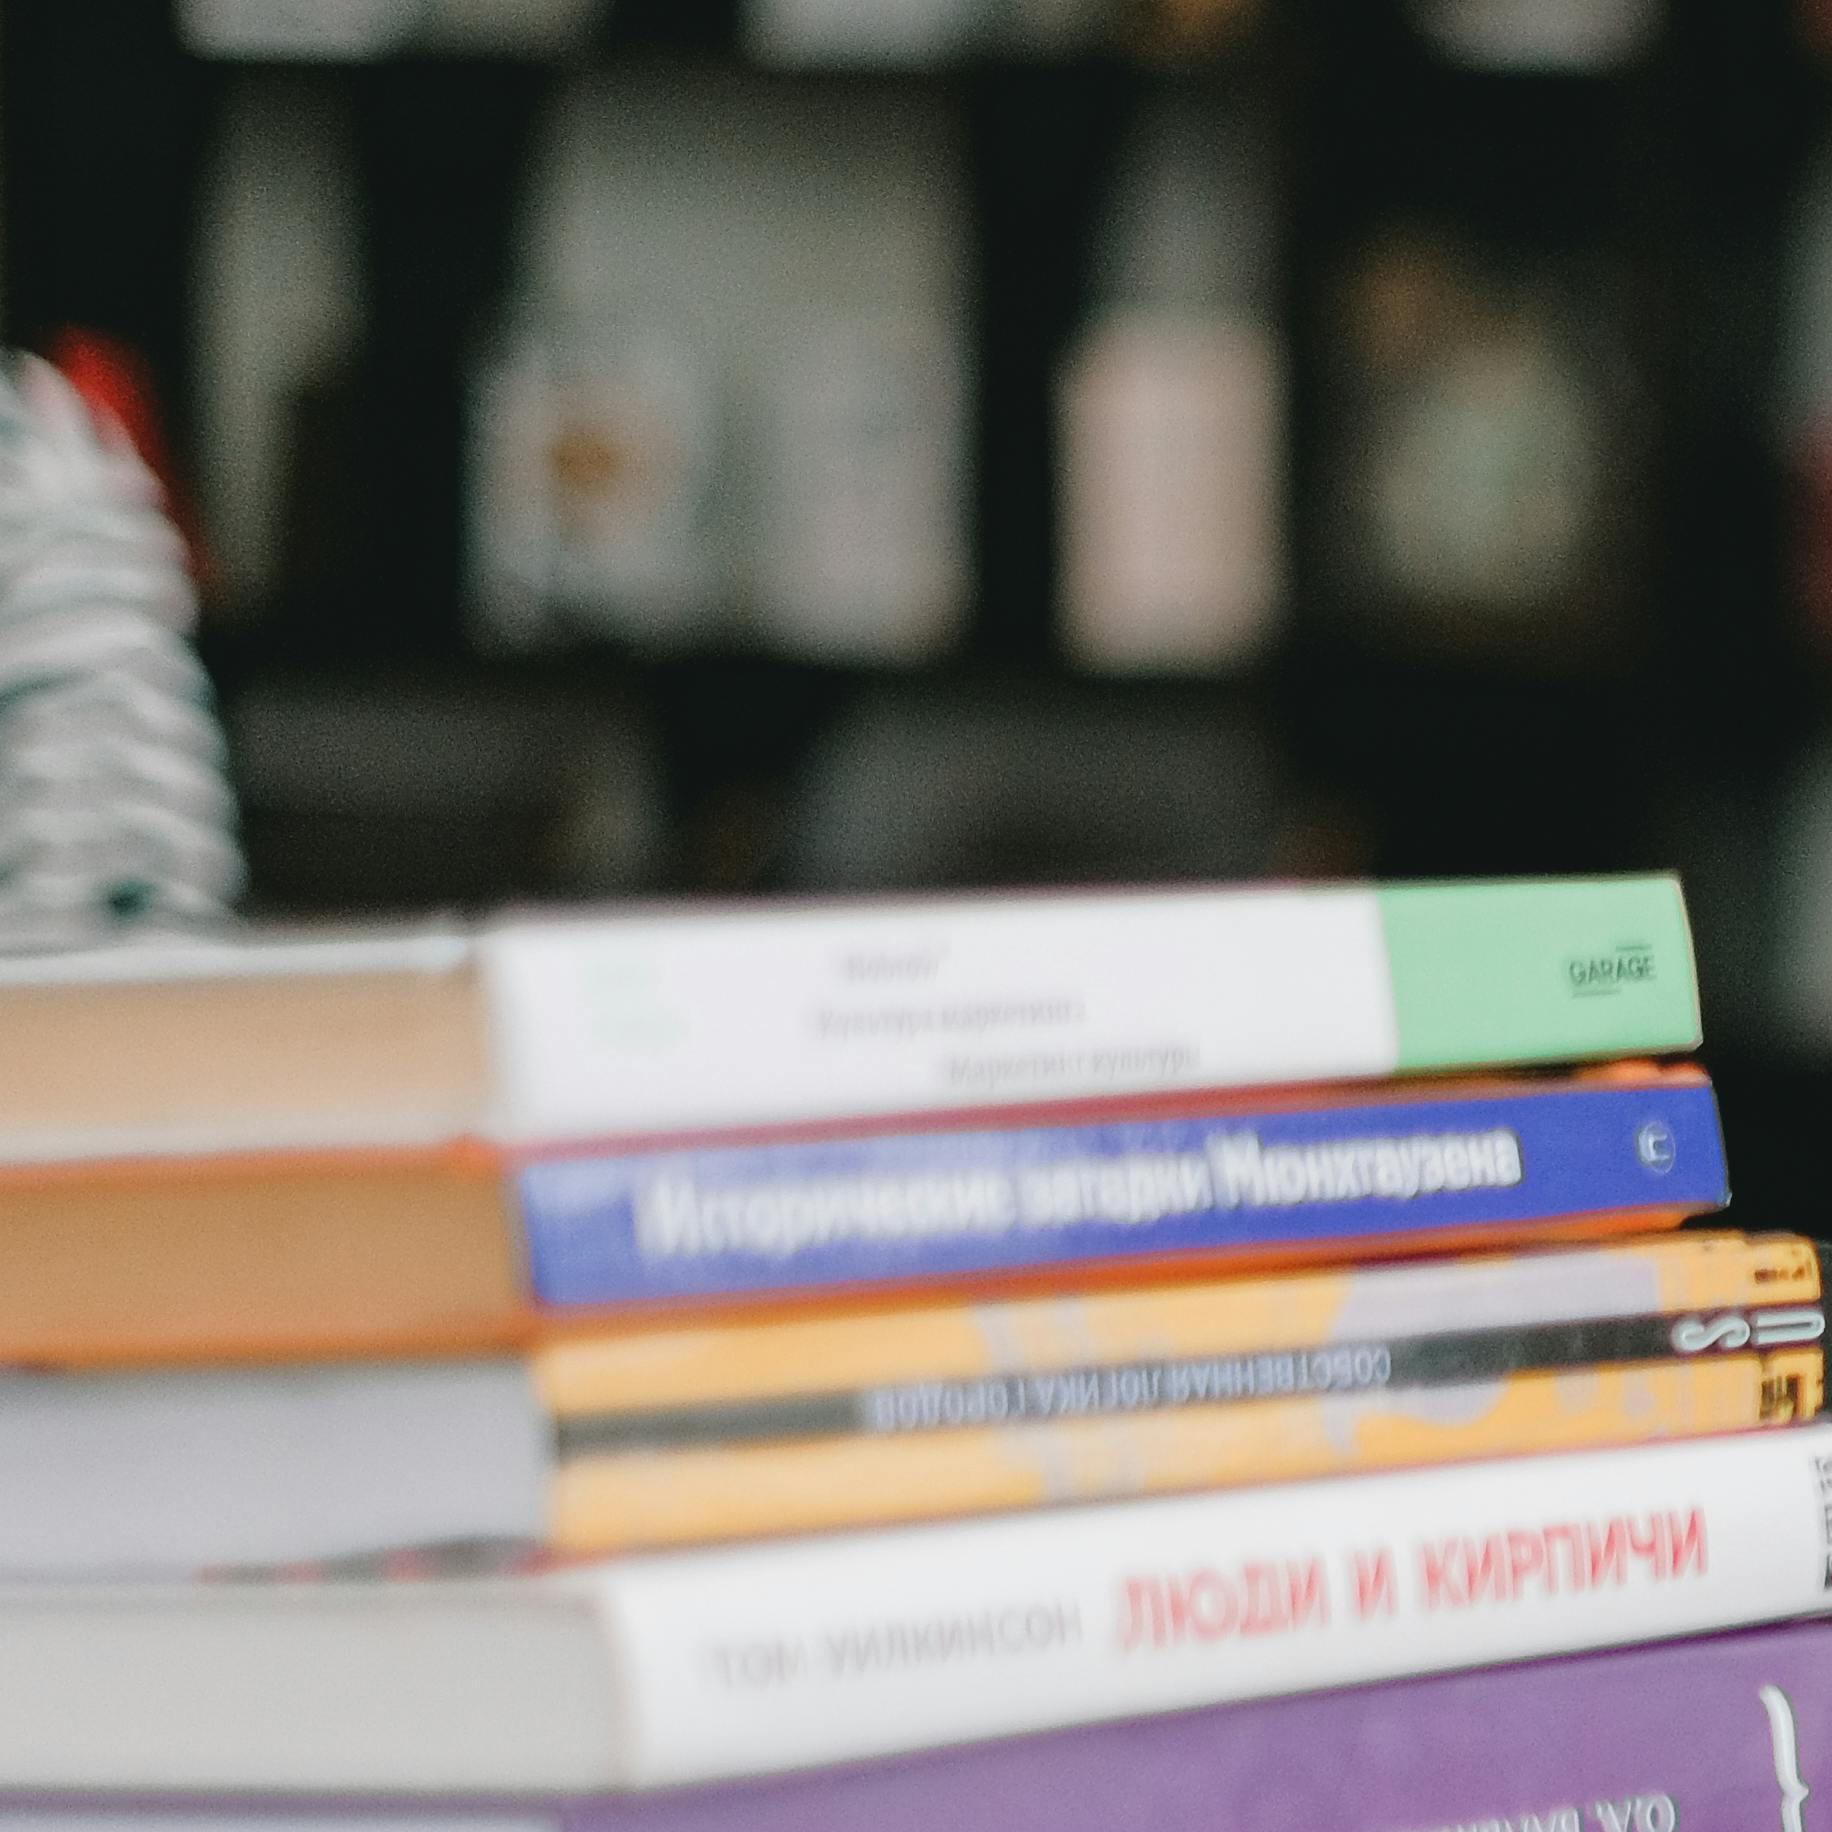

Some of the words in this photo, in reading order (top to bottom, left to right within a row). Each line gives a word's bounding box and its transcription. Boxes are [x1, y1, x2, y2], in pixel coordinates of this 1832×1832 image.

[1567, 951, 1657, 988] GARAGE
[638, 1168, 1016, 1258] Исторические
[1020, 1153, 1208, 1227] загадки
[1209, 1128, 1522, 1206] Мюнхгаузена
[1036, 1365, 1160, 1418] ЛОГИКА
[1172, 1346, 1390, 1399] СОБСТВЕННАЯ
[871, 1375, 1027, 1433] ГОРОДОВ
[1121, 1553, 1329, 1651] ЛЮДИ
[1351, 1545, 1396, 1622] И
[1420, 1505, 1709, 1610] КИРПИЧИ
[712, 1638, 806, 1690] ТОМ
[824, 1601, 1083, 1676] УИЛКИНСОН
